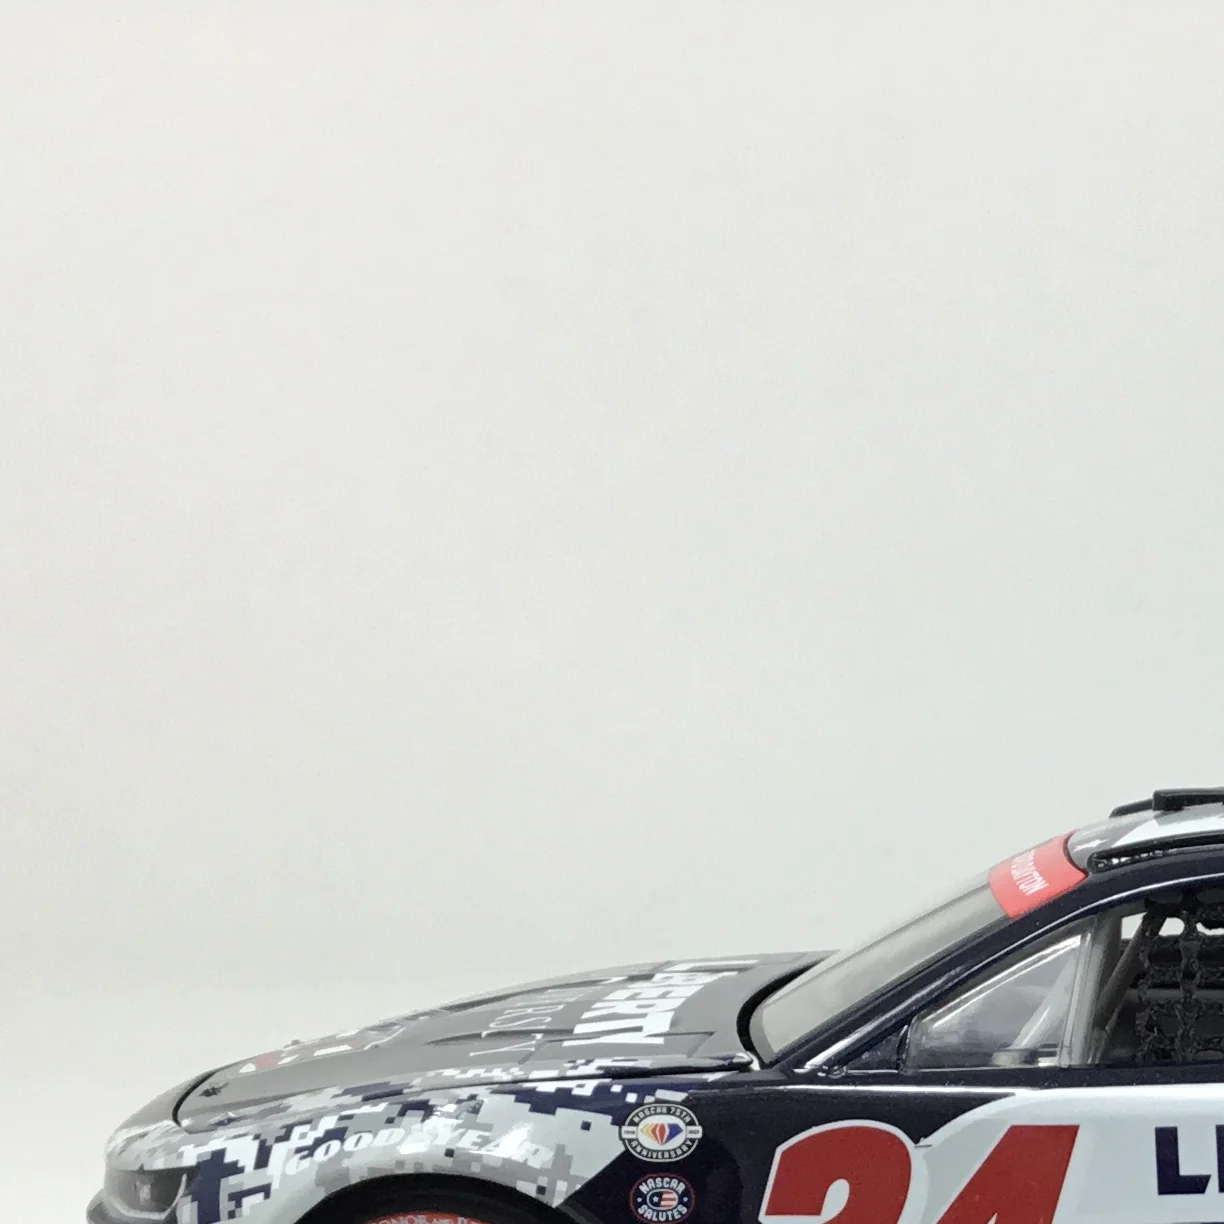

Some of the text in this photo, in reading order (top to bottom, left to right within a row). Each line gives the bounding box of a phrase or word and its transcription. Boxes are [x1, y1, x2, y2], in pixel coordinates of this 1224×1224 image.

[632, 1106, 692, 1123] NASCAR 75TH
[630, 1139, 693, 1159] ANNIVERSARY
[638, 1177, 687, 1195] NASCAR
[637, 1203, 688, 1221] SALUTES
